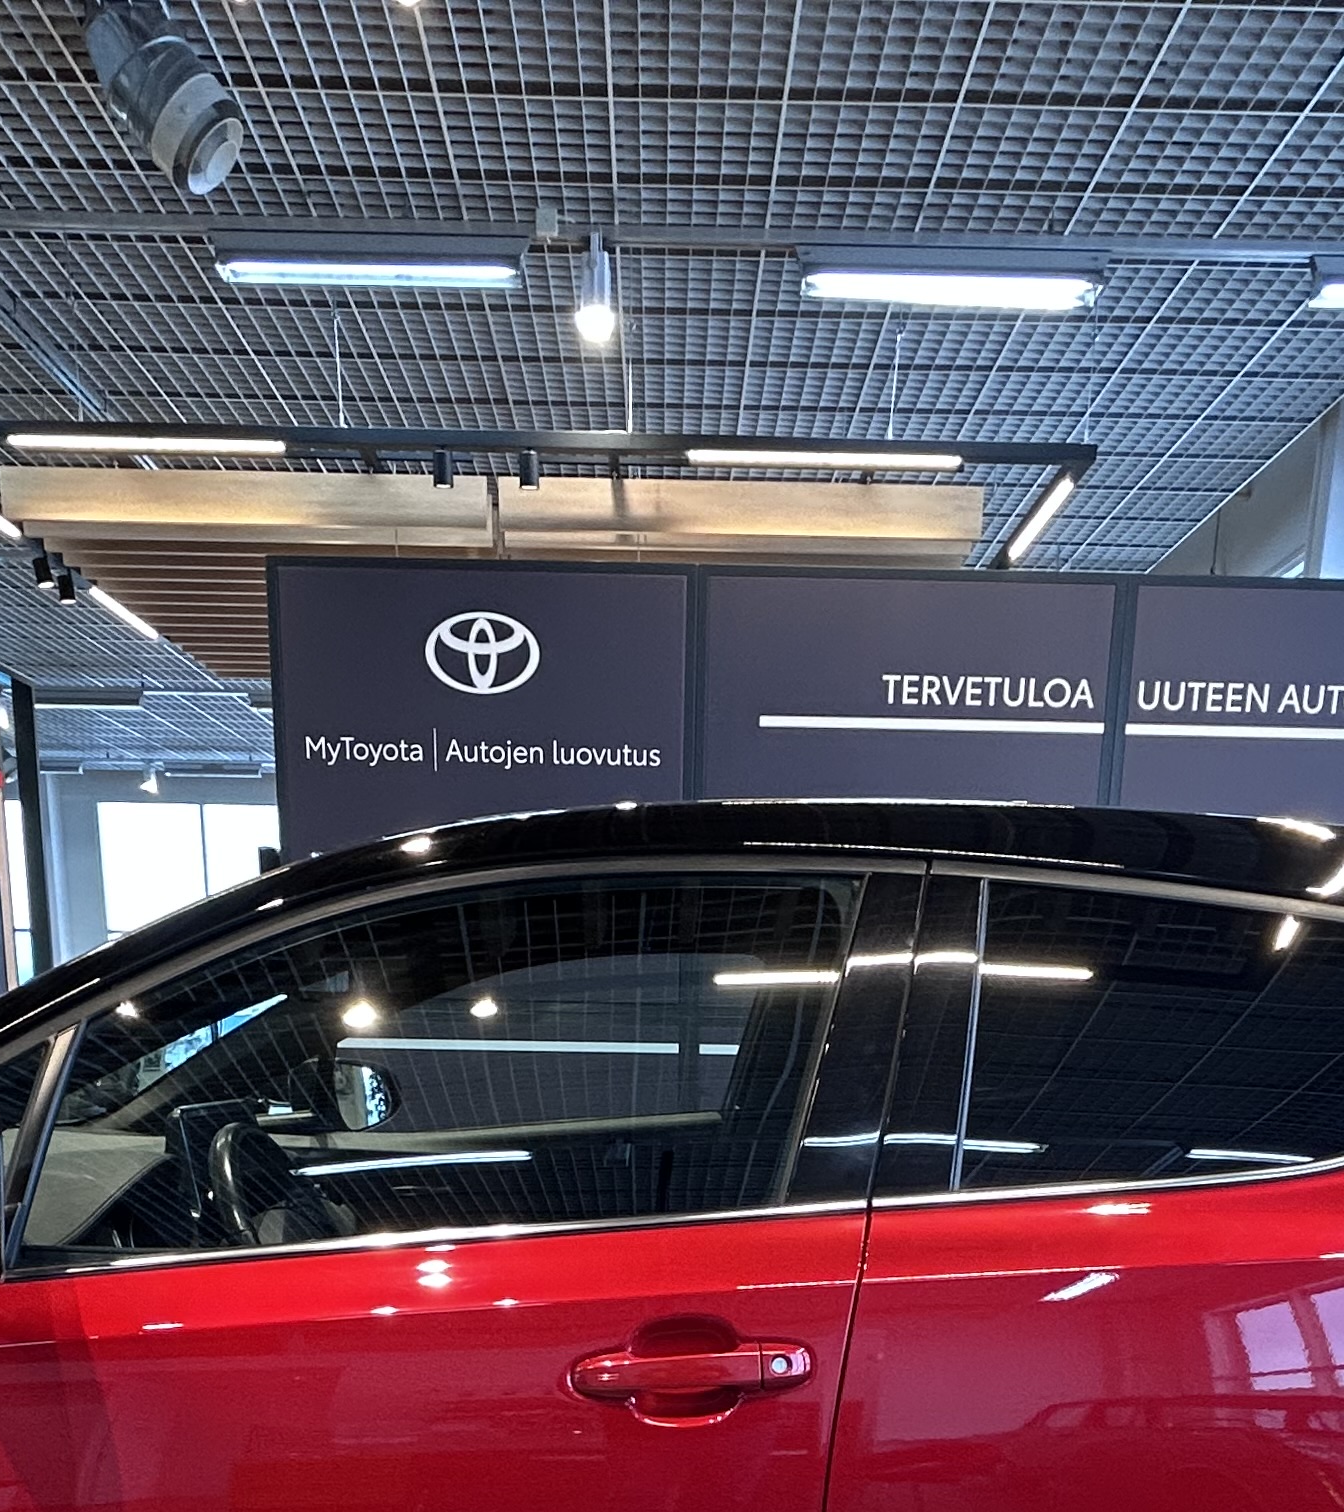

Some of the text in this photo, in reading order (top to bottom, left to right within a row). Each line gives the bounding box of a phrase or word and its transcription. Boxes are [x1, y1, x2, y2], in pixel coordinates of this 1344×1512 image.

[882, 674, 1094, 709] TERVETULOA
[1137, 680, 1270, 713] UUTEEN
[305, 736, 423, 767] MyToyota
[445, 738, 661, 770] Autojen luovutus
